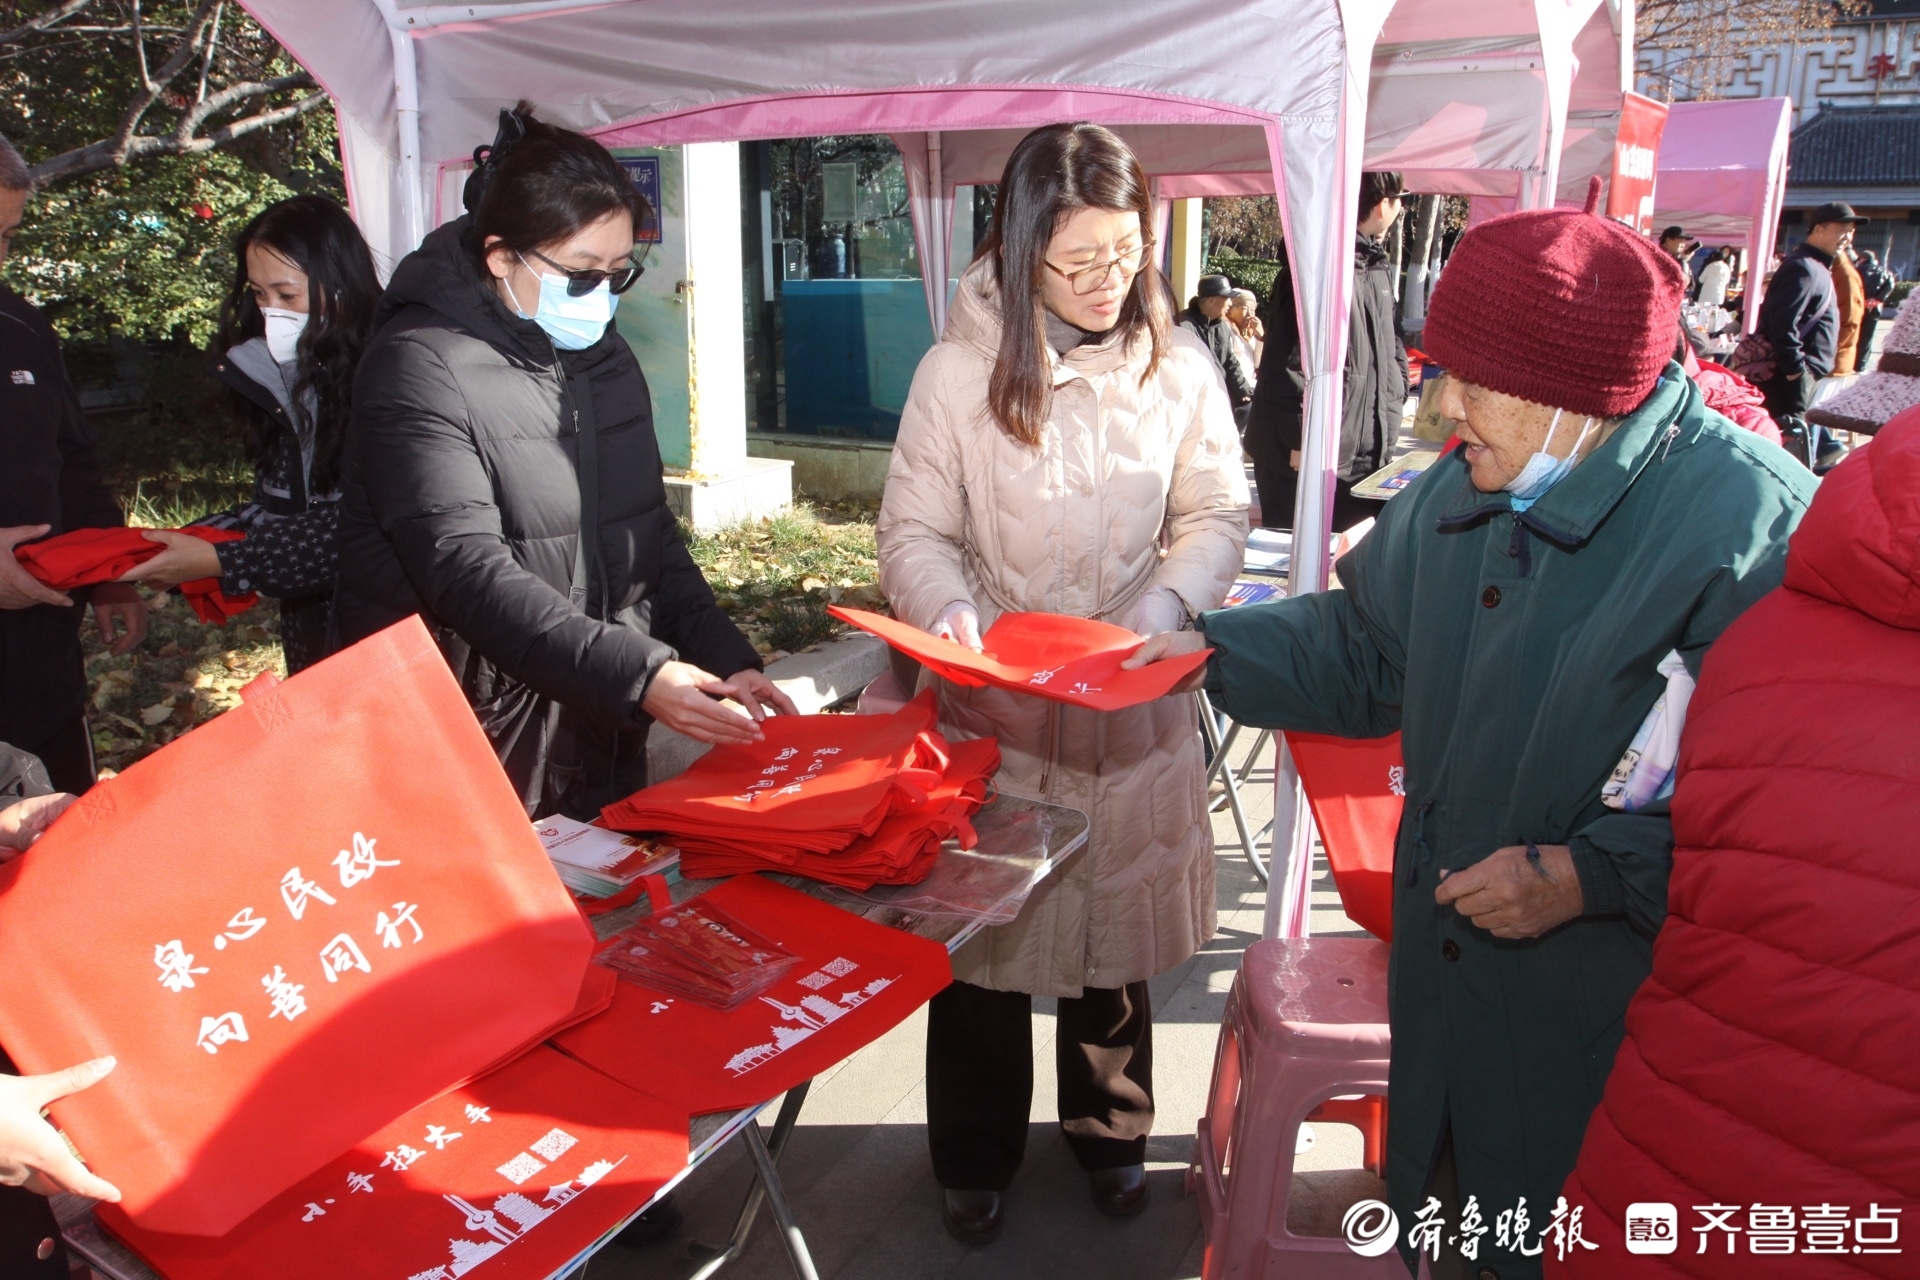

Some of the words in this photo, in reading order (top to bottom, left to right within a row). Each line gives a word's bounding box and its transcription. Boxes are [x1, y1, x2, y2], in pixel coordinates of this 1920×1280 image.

[153, 831, 402, 992] 泉心民政
[196, 901, 424, 1054] 向善同行
[301, 1103, 492, 1222] 小手拉大手
